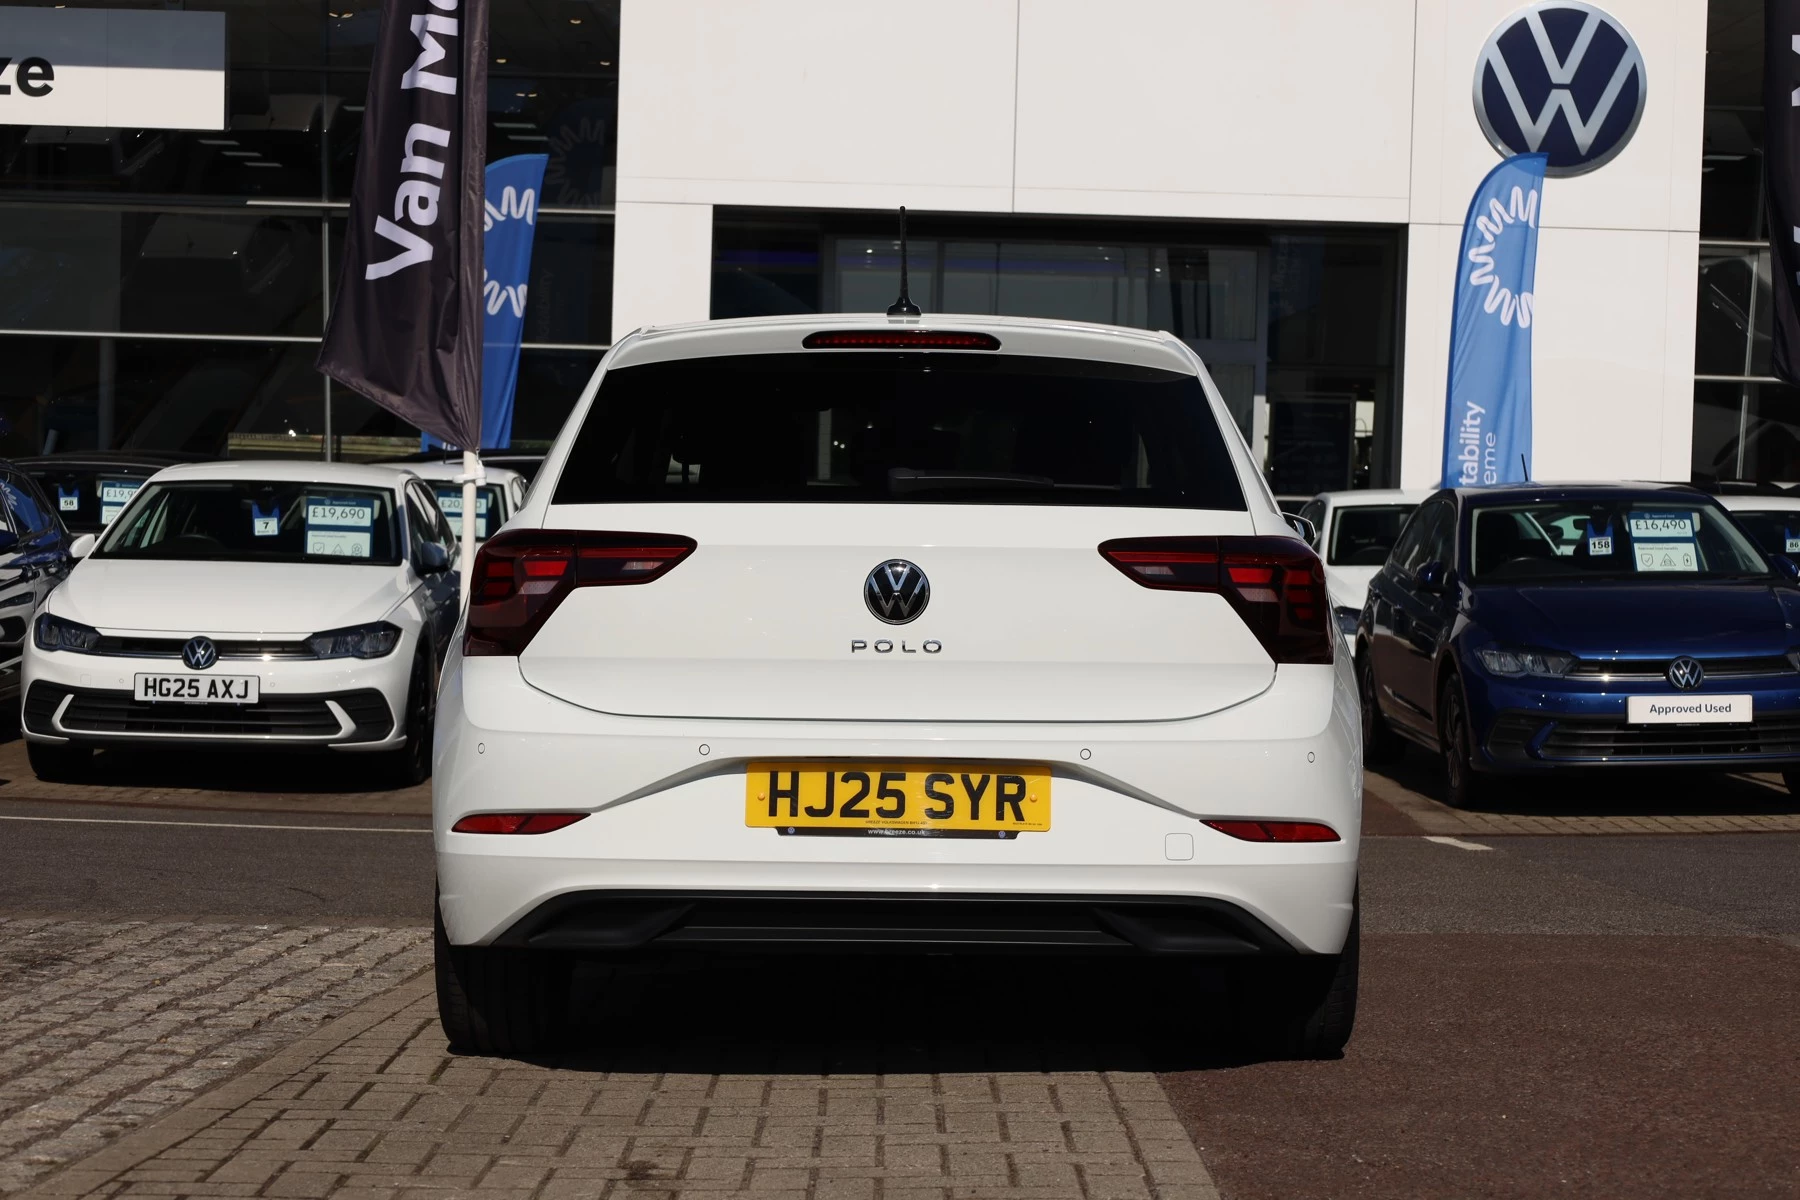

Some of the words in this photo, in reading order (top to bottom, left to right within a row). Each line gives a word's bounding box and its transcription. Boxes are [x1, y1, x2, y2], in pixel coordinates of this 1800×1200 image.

[401, 0, 460, 96] M
[365, 122, 451, 281] Van
[312, 507, 366, 520] £19,690
[263, 521, 270, 530] 7
[1635, 519, 1687, 532] £16,490
[1592, 540, 1611, 550] 158
[851, 639, 943, 654] POLO
[144, 677, 200, 698] HG25
[206, 679, 249, 699] AXJ
[1649, 703, 1702, 716] Approved
[1704, 703, 1732, 714] Used
[768, 770, 907, 819] HJ25
[924, 772, 1027, 822] SYR
